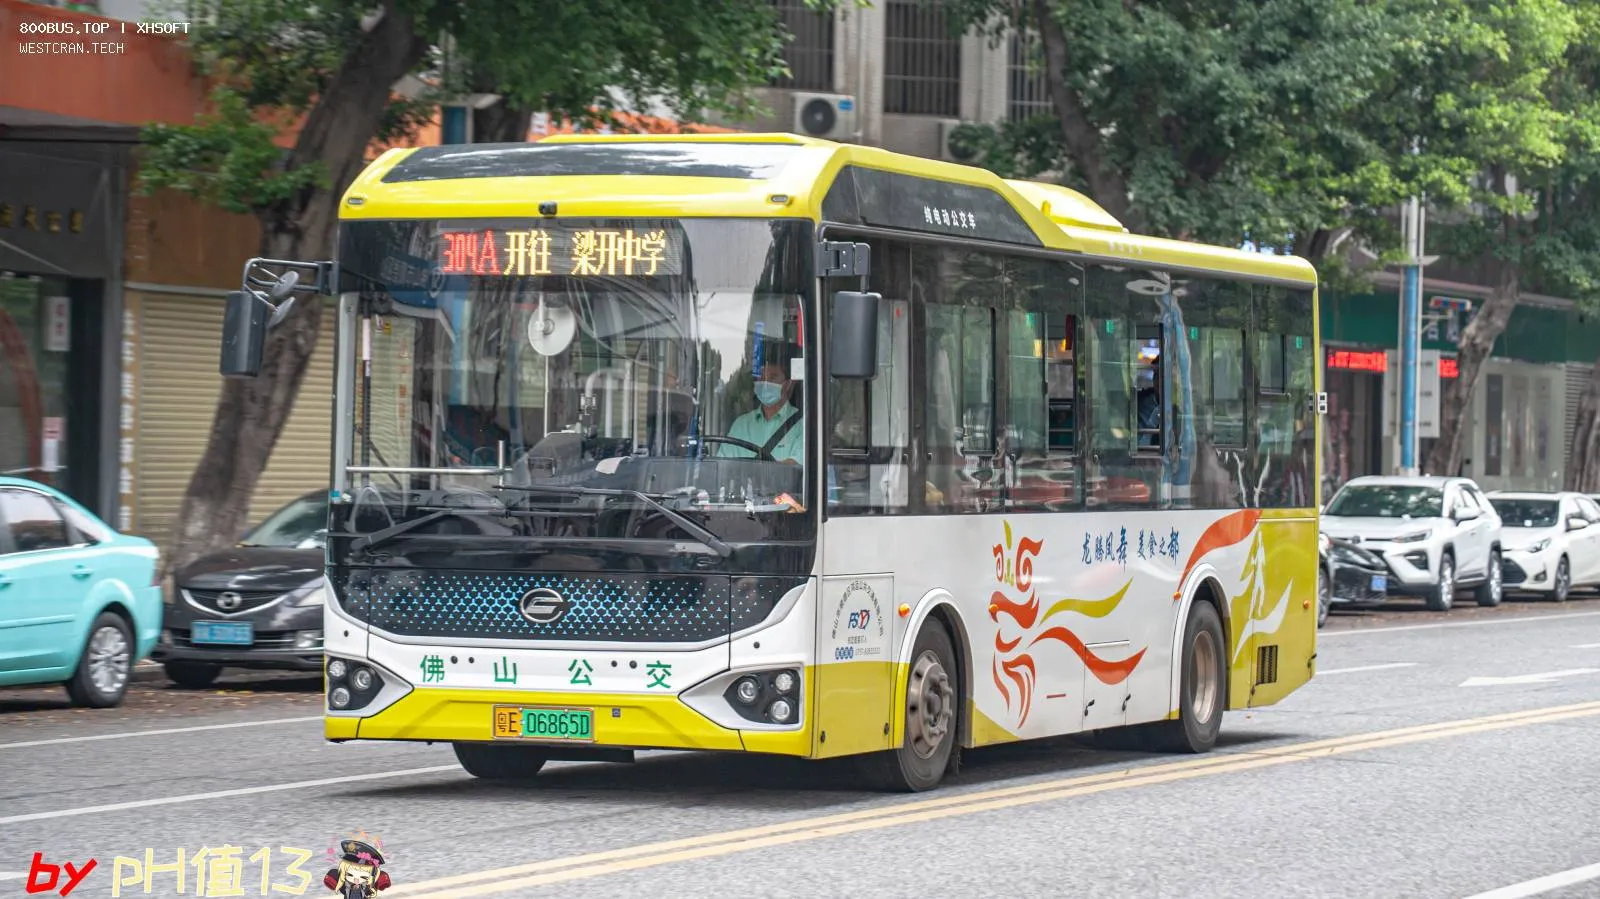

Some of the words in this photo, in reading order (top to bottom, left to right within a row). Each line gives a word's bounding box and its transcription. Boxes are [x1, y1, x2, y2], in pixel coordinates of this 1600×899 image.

[443, 227, 500, 274] 304A
[503, 230, 553, 276] 开往
[571, 229, 666, 276] 梁开中学
[419, 654, 673, 690] 佛山公交
